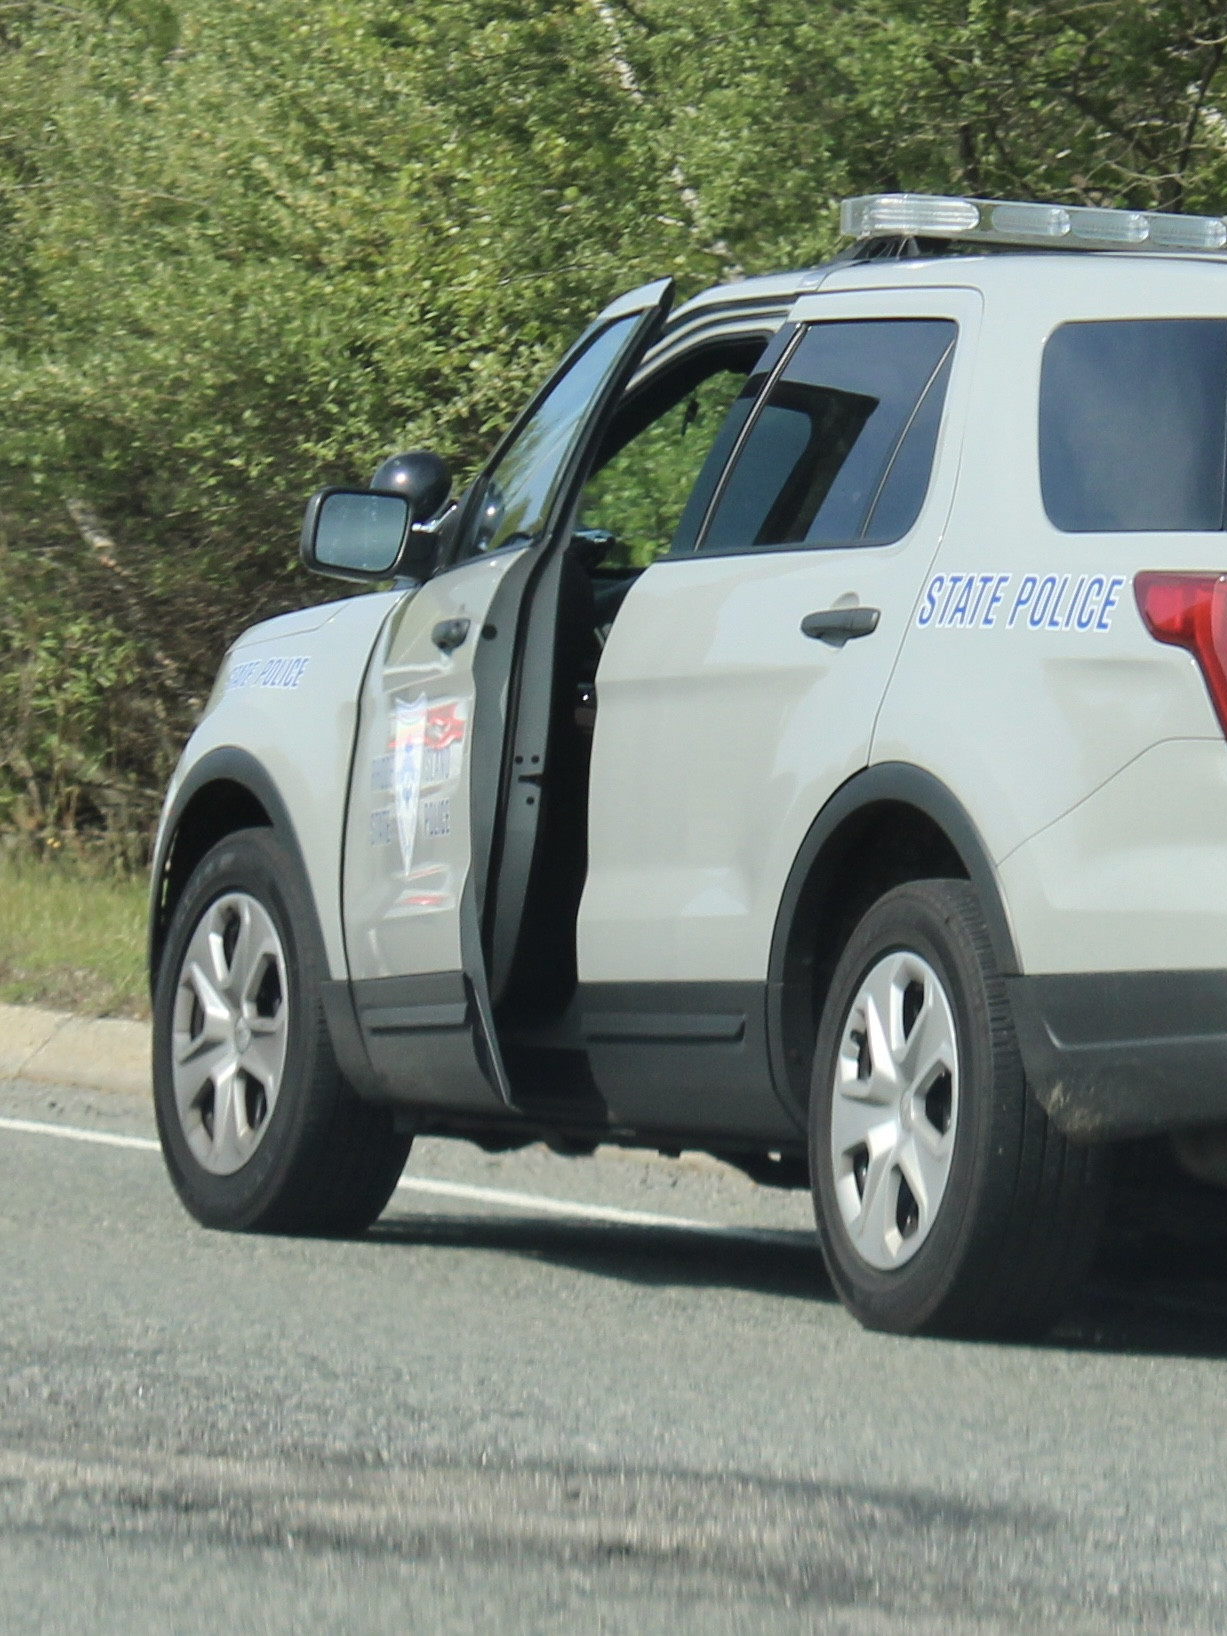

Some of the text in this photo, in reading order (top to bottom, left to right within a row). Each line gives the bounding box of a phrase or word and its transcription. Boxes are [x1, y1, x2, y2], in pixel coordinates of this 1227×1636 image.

[917, 572, 1126, 632] STATE POLICE
[255, 656, 310, 689] POLICE
